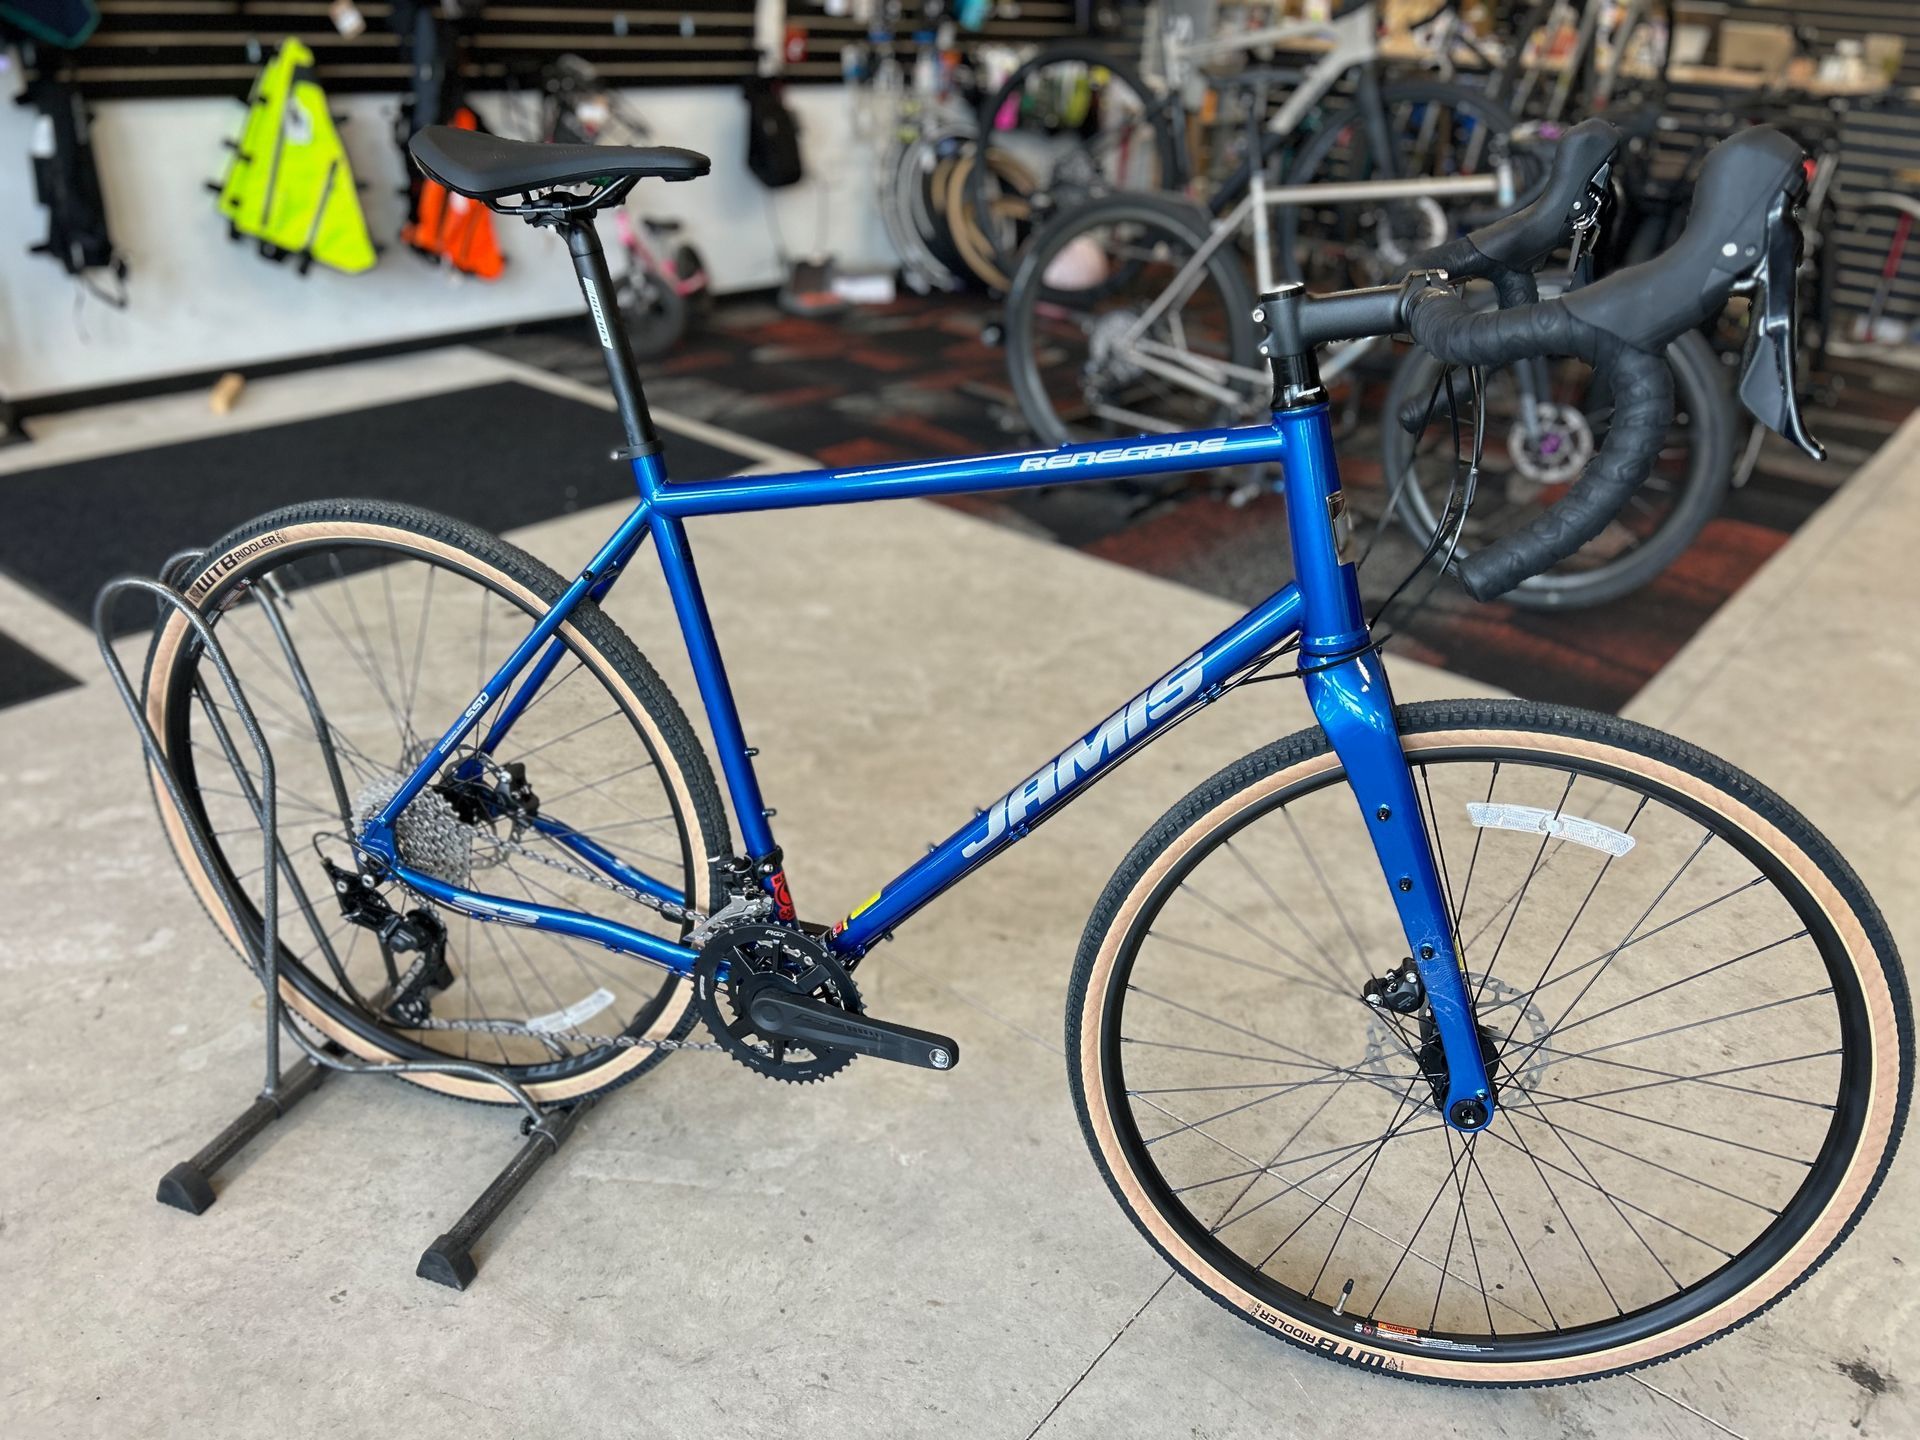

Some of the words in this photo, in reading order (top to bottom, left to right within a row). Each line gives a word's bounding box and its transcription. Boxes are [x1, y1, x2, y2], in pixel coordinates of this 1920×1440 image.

[1019, 437, 1227, 472] RENEGADE
[195, 554, 238, 592] WTB
[234, 535, 277, 560] RIDDLER
[465, 692, 489, 718] SSD
[962, 652, 1203, 858] JAMIS
[1259, 1310, 1317, 1344] RIDDLER
[1315, 1337, 1386, 1368] WTB
